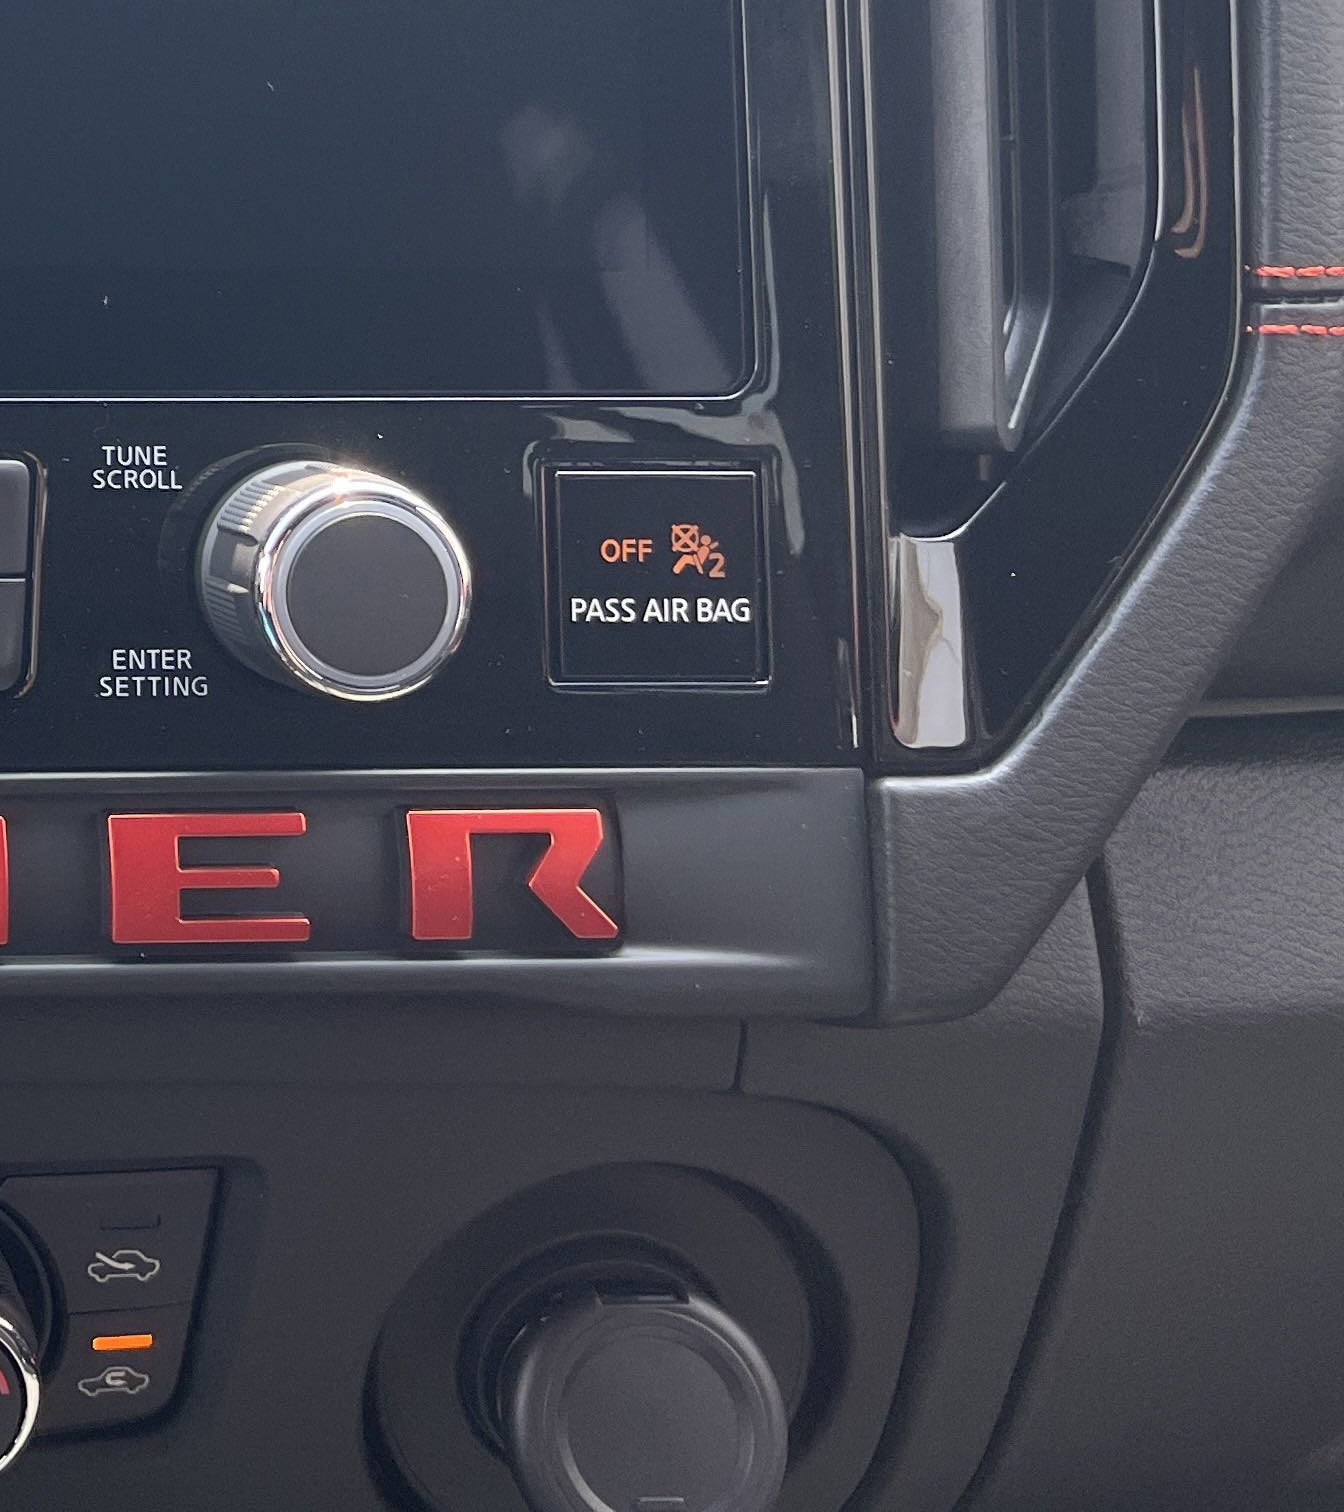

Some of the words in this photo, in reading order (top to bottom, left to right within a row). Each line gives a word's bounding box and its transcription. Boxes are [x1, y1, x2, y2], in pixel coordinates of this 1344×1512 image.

[101, 445, 168, 467] TUNE
[92, 468, 183, 491] SCROLL
[600, 538, 653, 563] OFF
[570, 597, 637, 624] PASS
[642, 597, 690, 624] AIR
[696, 597, 752, 624] BAG
[111, 648, 193, 672] ENTER
[99, 674, 209, 698] SETTING
